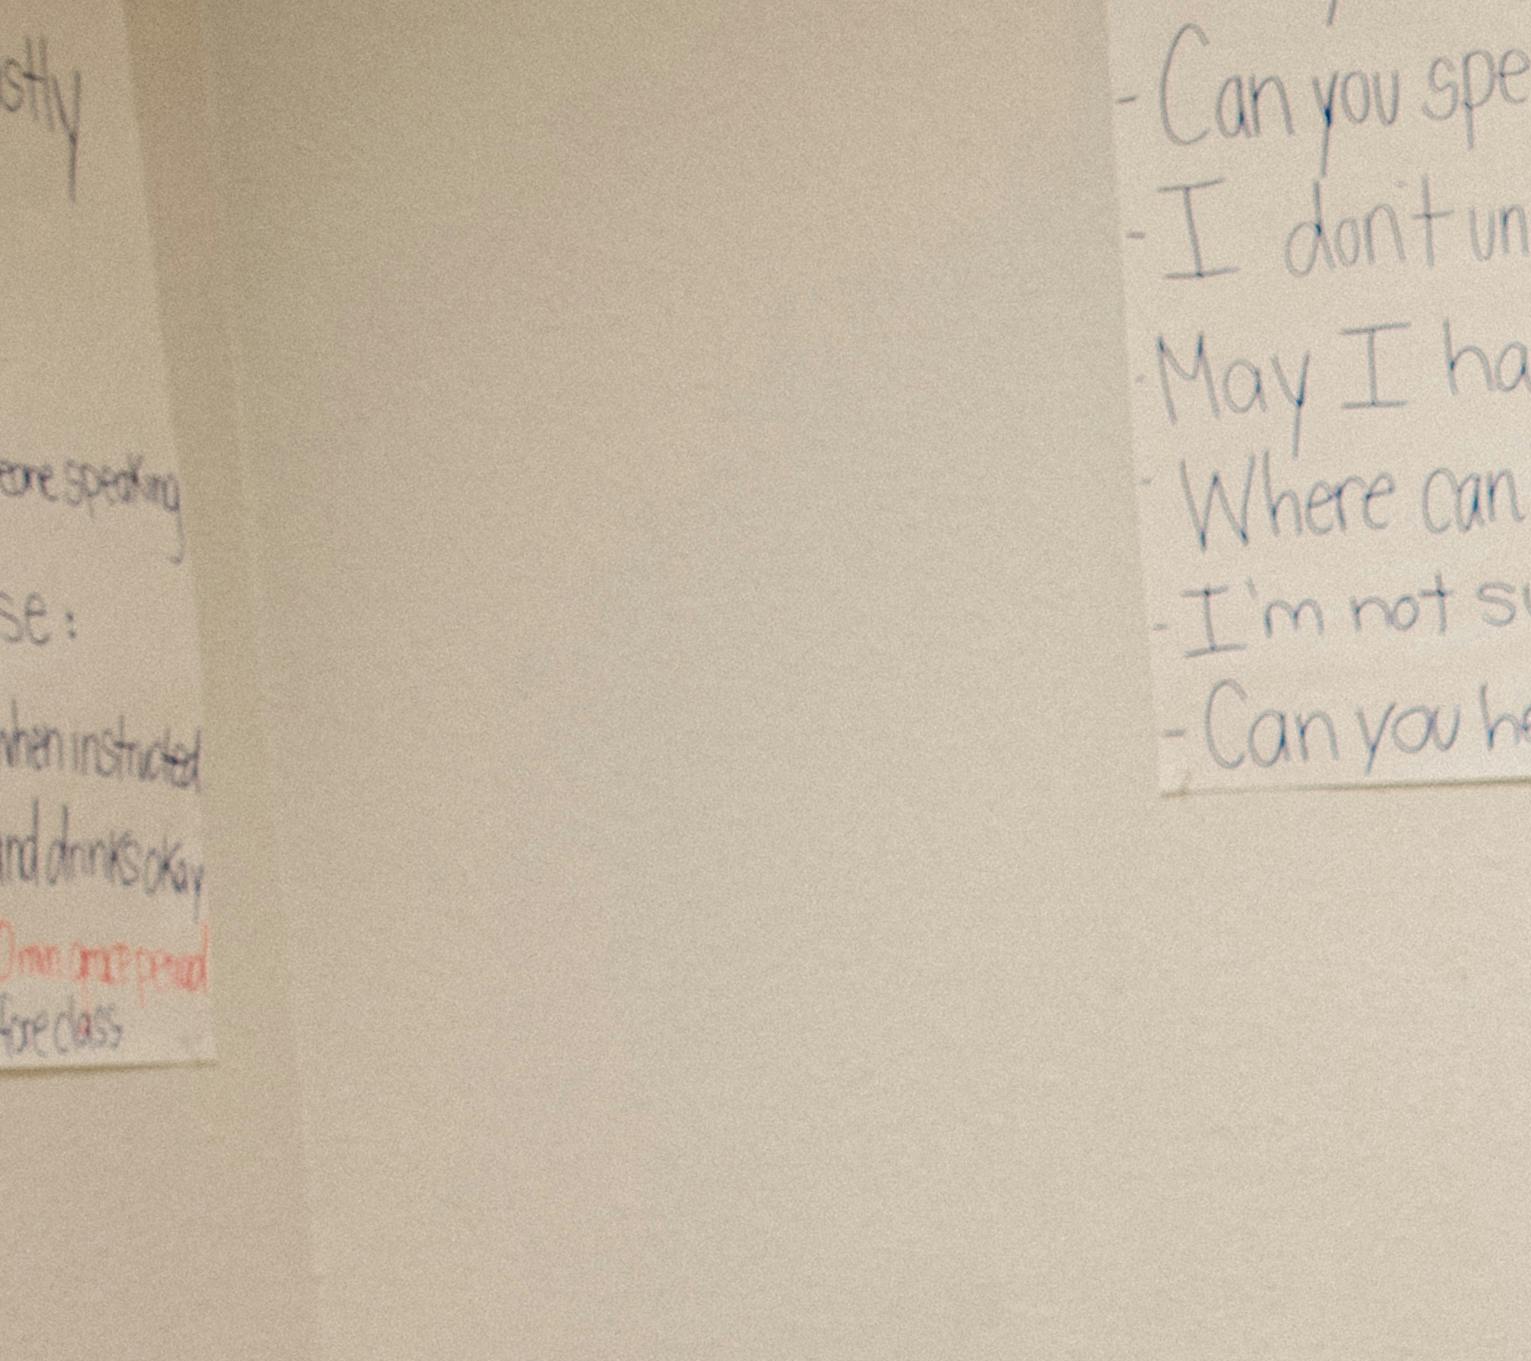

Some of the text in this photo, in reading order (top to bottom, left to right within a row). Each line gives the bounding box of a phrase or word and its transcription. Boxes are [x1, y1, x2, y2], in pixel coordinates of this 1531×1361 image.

[1160, 24, 1294, 144] Can
[1313, 71, 1399, 177] you
[1157, 178, 1240, 279] I
[1158, 330, 1310, 459] May
[1339, 323, 1411, 408] I
[1180, 450, 1396, 551] Where
[1422, 467, 1525, 533] can
[1181, 576, 1325, 658] I'm
[1353, 570, 1453, 634] not
[1205, 679, 1338, 769] Can
[1358, 702, 1461, 775] you
